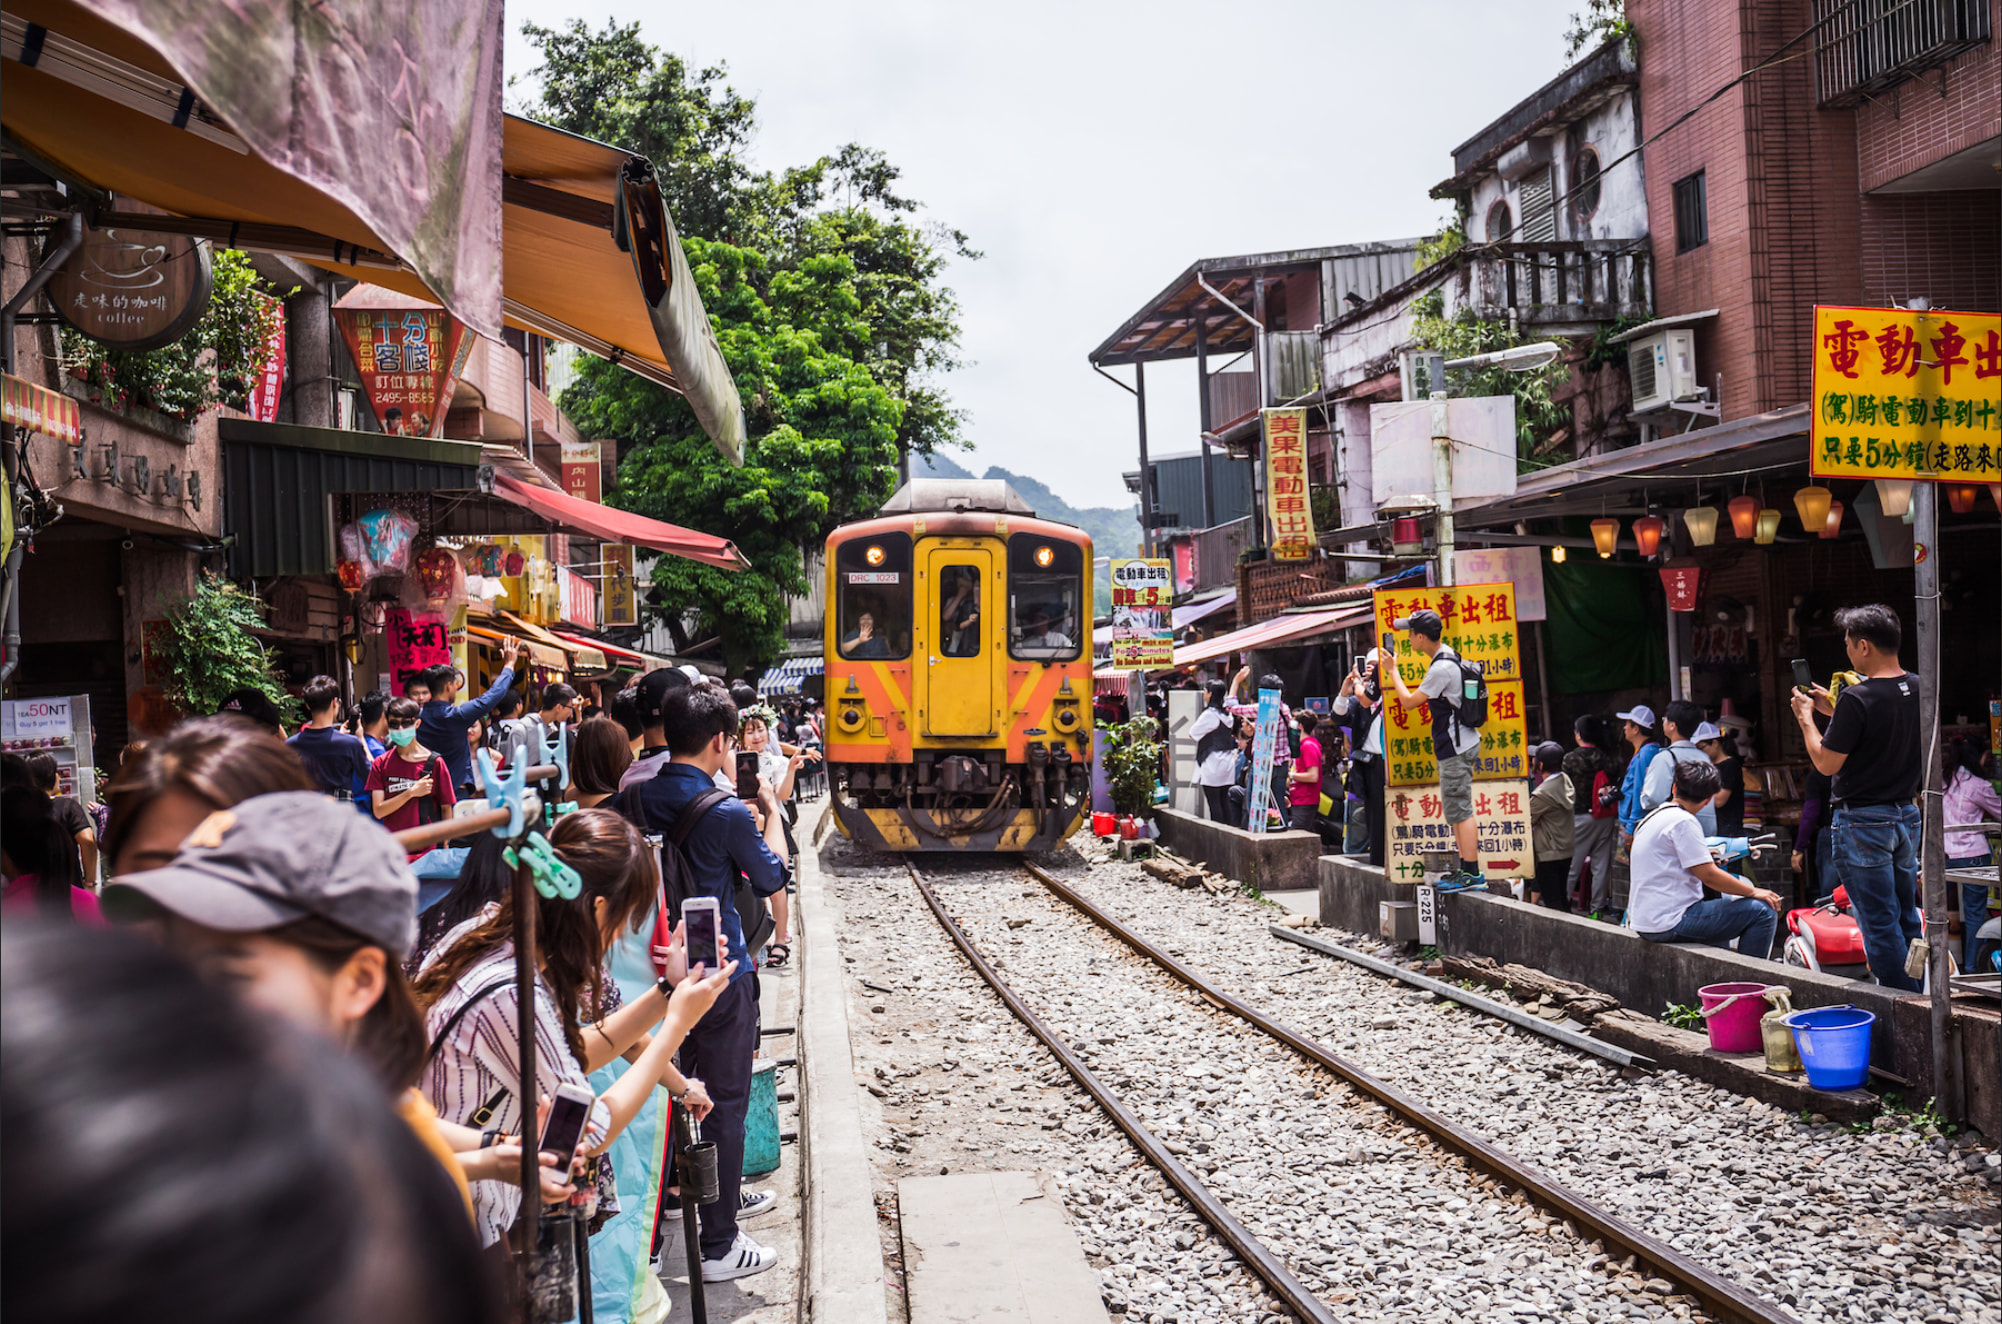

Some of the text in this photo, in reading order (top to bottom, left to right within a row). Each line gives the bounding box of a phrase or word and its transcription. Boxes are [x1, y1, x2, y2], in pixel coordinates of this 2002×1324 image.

[373, 312, 428, 343] 十分
[1823, 319, 2001, 386] 電動車出
[1821, 391, 2001, 430] (駕)騎電動車到十
[1822, 437, 2001, 473] 只要5分鐘(走路來
[1269, 415, 1308, 559] 美果電動車出租
[850, 574, 896, 582] DRC 1023
[1391, 792, 1523, 821] 電動出租
